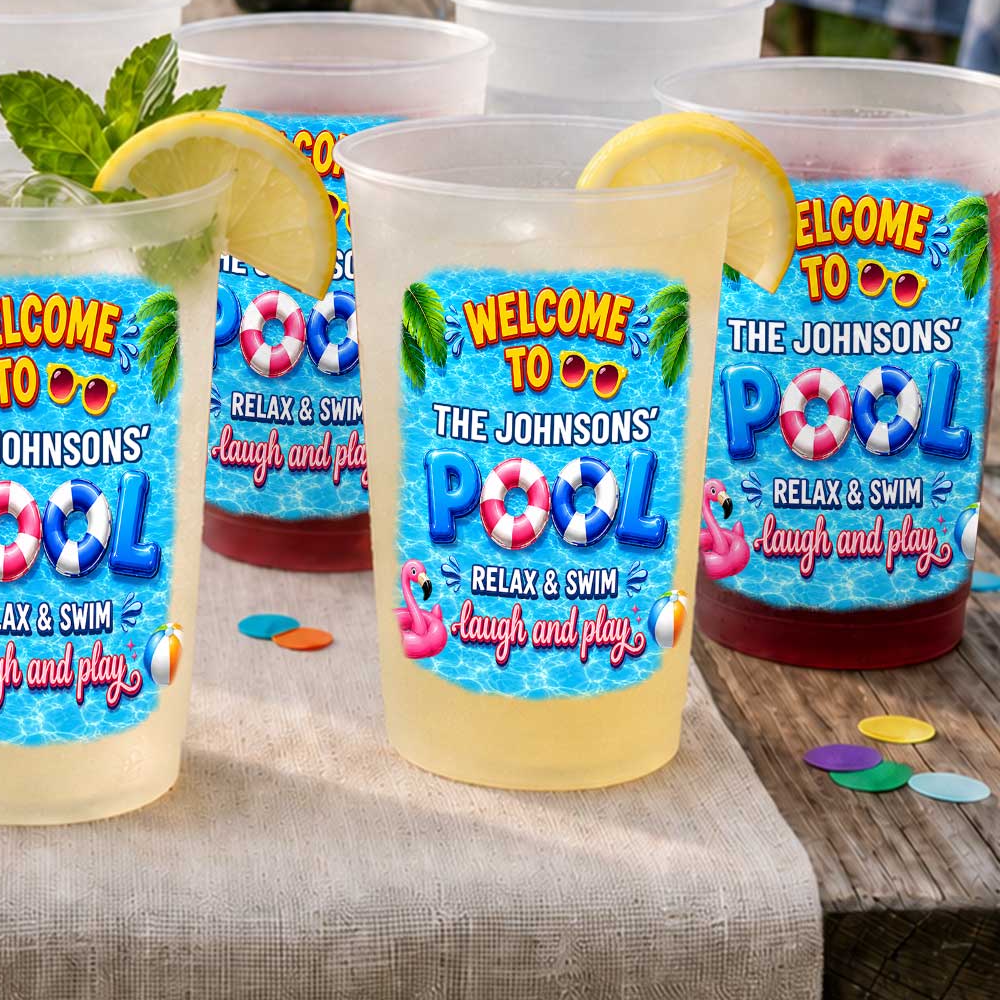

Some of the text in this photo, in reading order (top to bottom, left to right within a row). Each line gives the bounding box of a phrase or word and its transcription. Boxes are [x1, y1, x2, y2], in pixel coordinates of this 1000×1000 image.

[796, 194, 933, 255] ELCOME
[800, 252, 850, 302] TO
[463, 287, 635, 349] WELCOME
[727, 317, 962, 356] THE JOHNSONS'
[504, 345, 552, 393] TO
[231, 391, 295, 425] RELAX
[298, 396, 314, 426] &
[432, 402, 660, 447] THE JOHNSONS'
[720, 358, 972, 462] POOL
[211, 424, 369, 489] laugh and pla
[423, 447, 668, 551] POOL
[773, 477, 924, 510] RELAX & SWIM
[754, 512, 953, 579] laugh and play
[470, 565, 619, 599] RELAX & SWIM
[36, 601, 54, 633] &
[58, 600, 113, 632] SWIM
[451, 599, 646, 668] laugh and play
[27, 641, 73, 690] and
[76, 638, 142, 709] play
